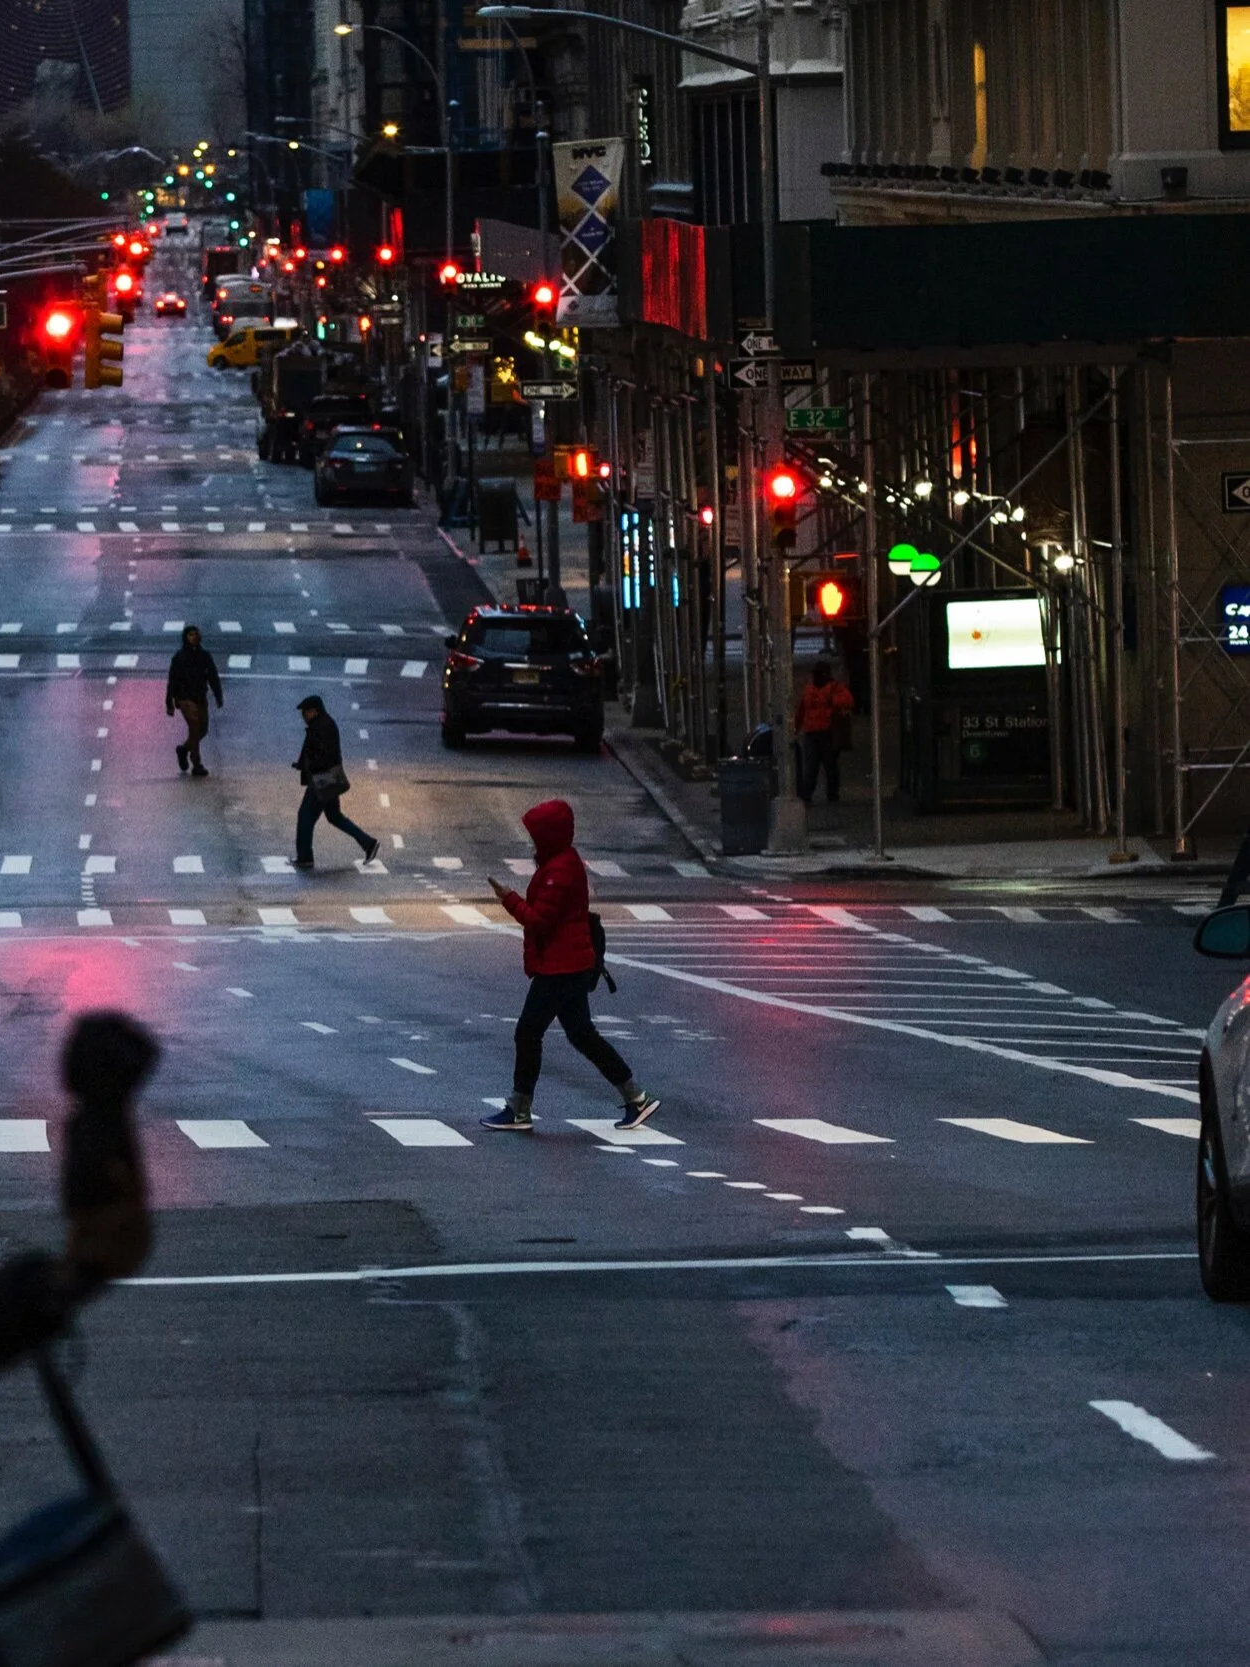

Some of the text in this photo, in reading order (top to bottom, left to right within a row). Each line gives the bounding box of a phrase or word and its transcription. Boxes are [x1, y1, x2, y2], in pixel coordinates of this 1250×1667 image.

[572, 146, 606, 160] NYC
[746, 338, 763, 350] ONE
[782, 367, 807, 379] WAY
[790, 410, 799, 427] E
[806, 410, 825, 427] 32
[1228, 625, 1249, 639] 24
[962, 716, 1049, 728] 33 St Station
[969, 744, 981, 758] 6
